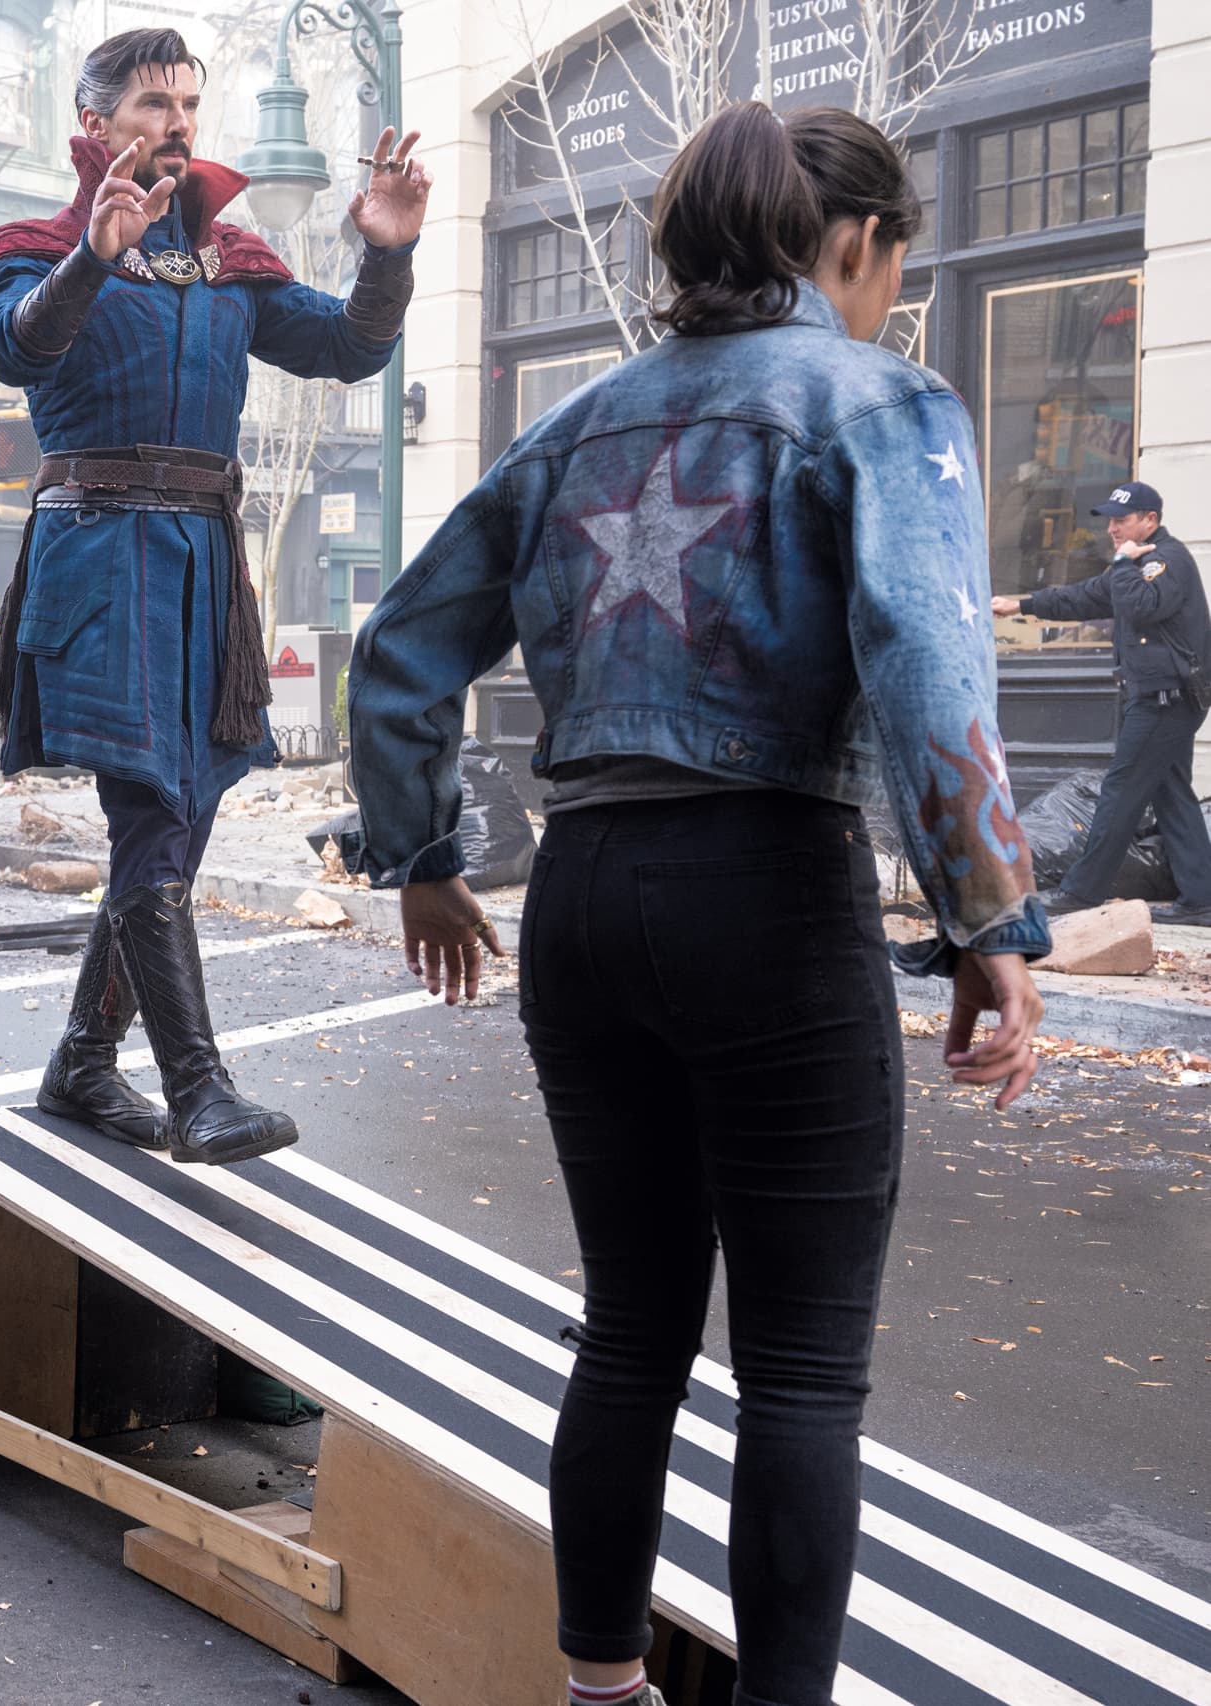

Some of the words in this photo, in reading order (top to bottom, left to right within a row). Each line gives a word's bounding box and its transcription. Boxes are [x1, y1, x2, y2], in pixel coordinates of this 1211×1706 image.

[755, 24, 856, 68] SHIRTING
[967, 2, 1086, 52] FASHIONS
[773, 59, 859, 97] SUITING
[567, 90, 630, 121] EXOTIC
[570, 123, 626, 153] SHOES
